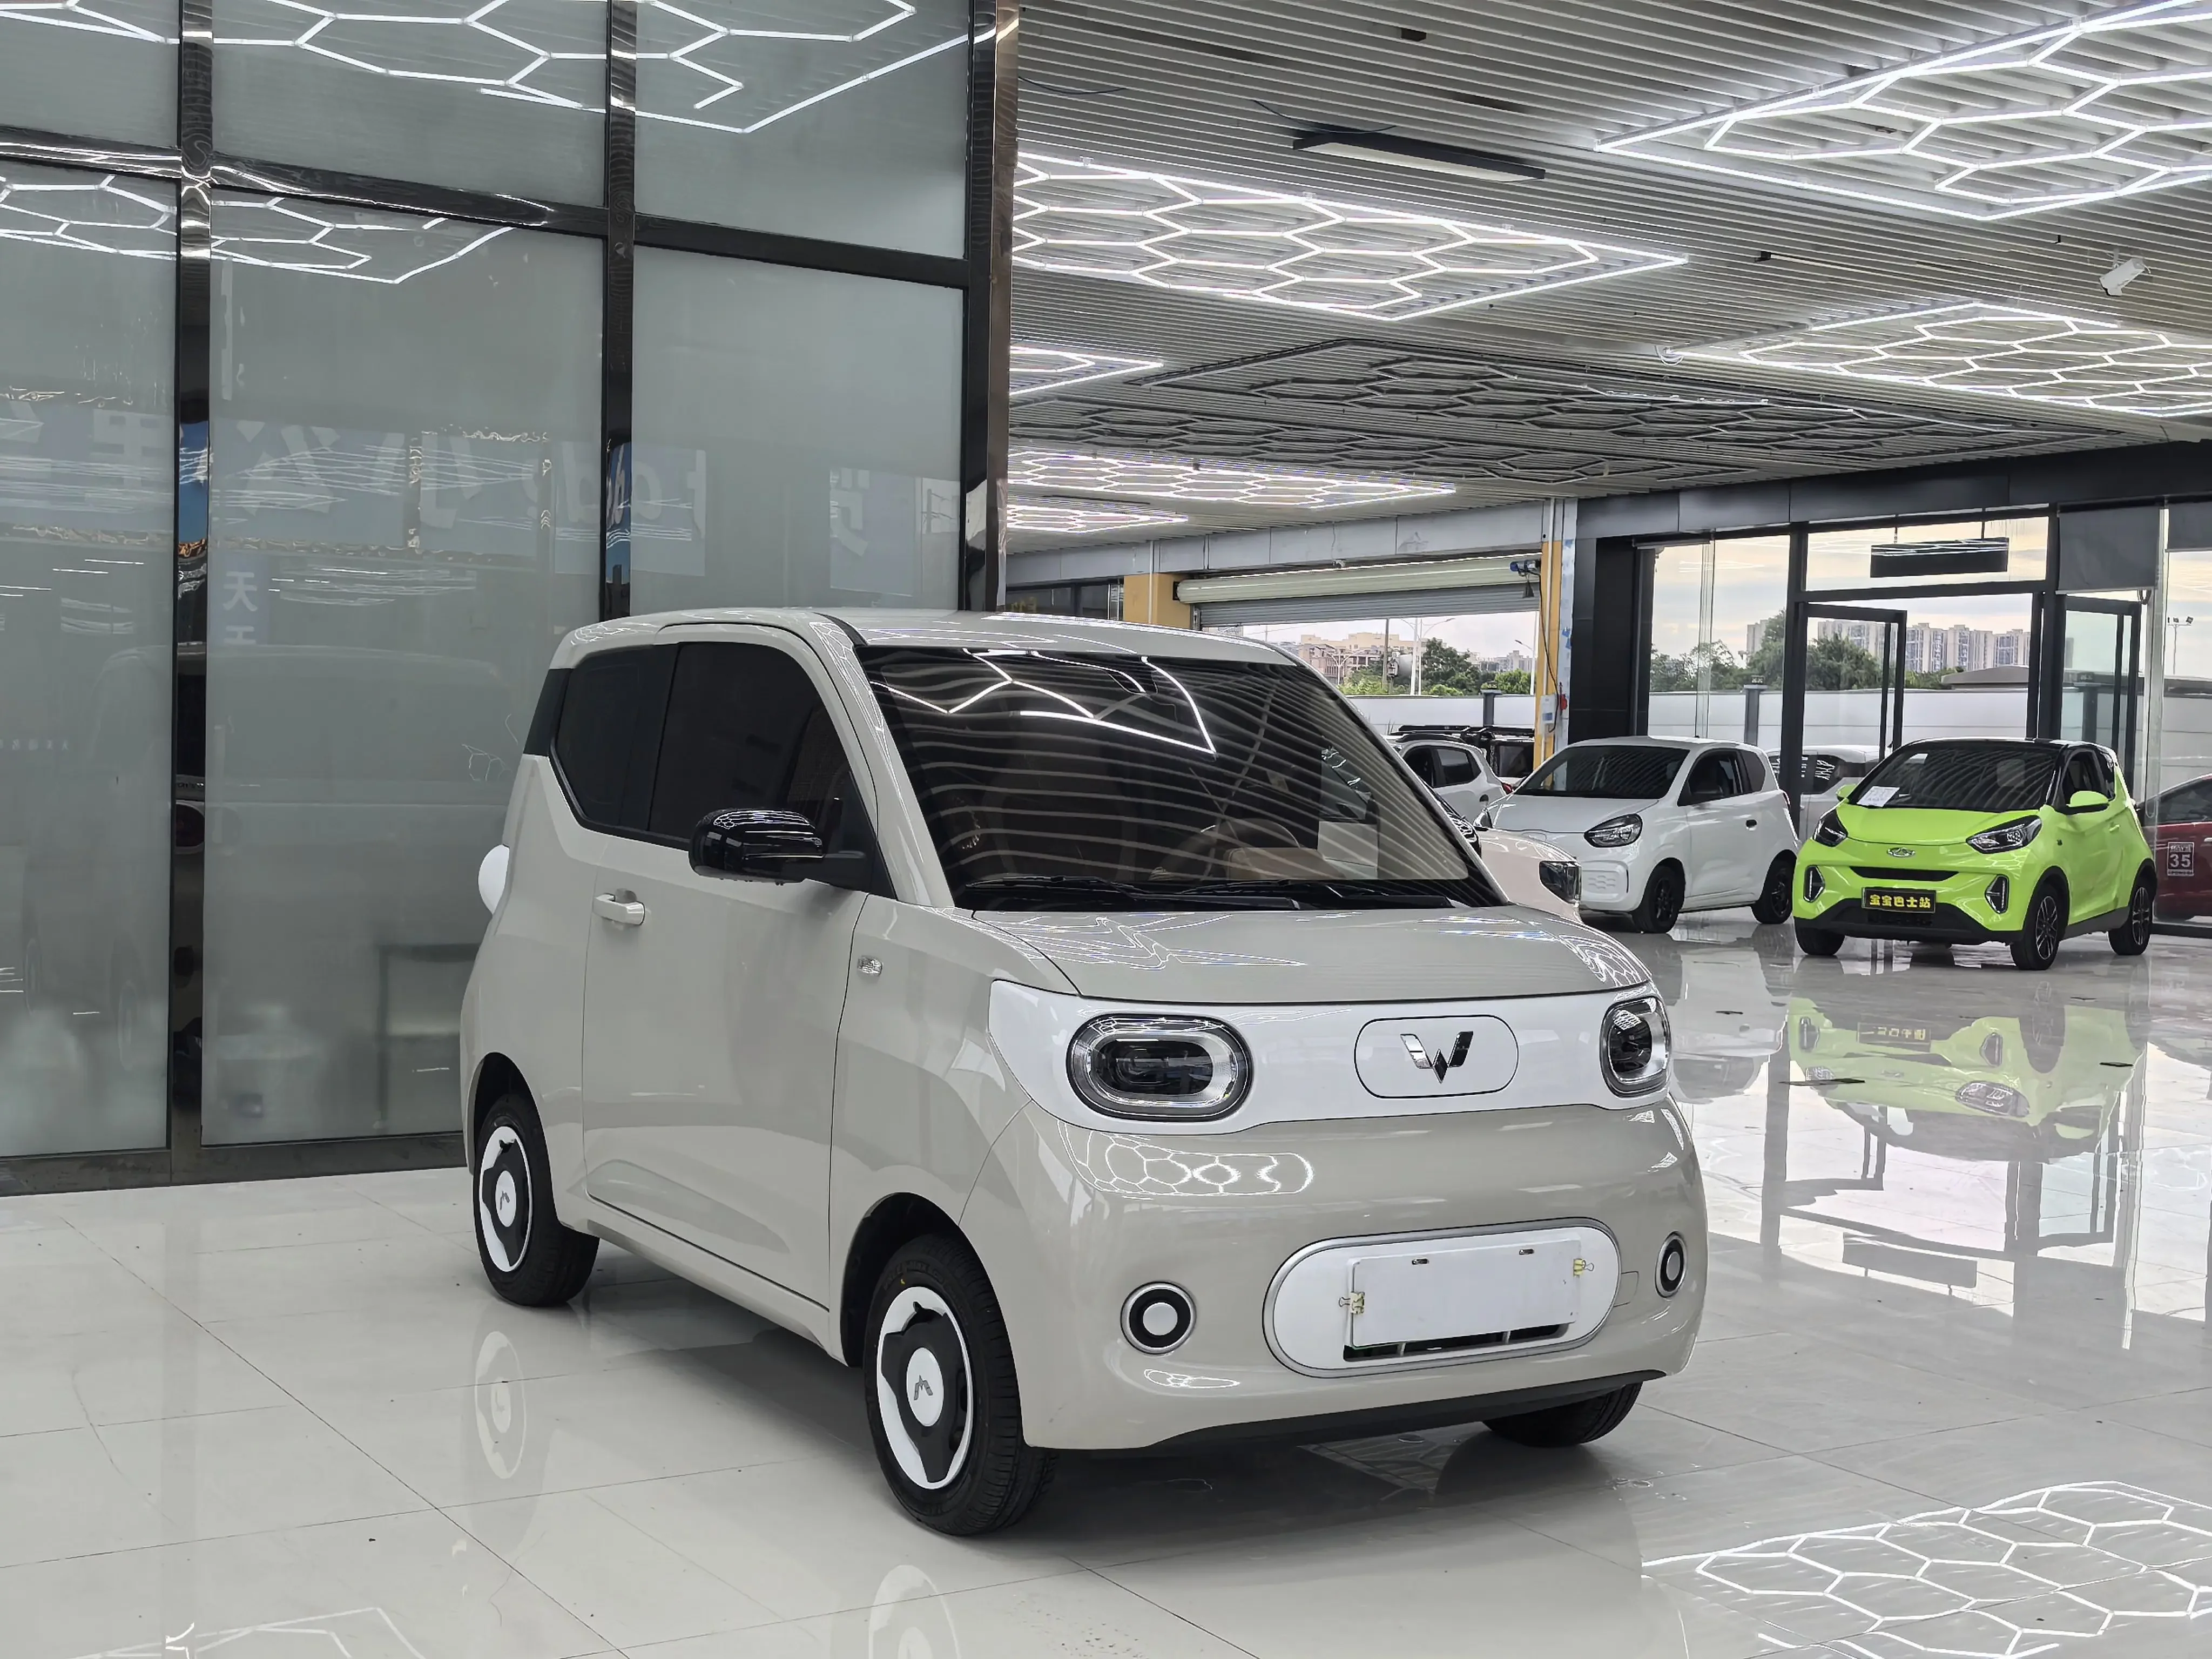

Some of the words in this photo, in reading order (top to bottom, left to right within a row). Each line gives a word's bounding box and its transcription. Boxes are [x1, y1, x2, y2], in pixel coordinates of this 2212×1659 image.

[2169, 853, 2191, 868] 35
[1869, 894, 1931, 909] 宝宝巴士站
